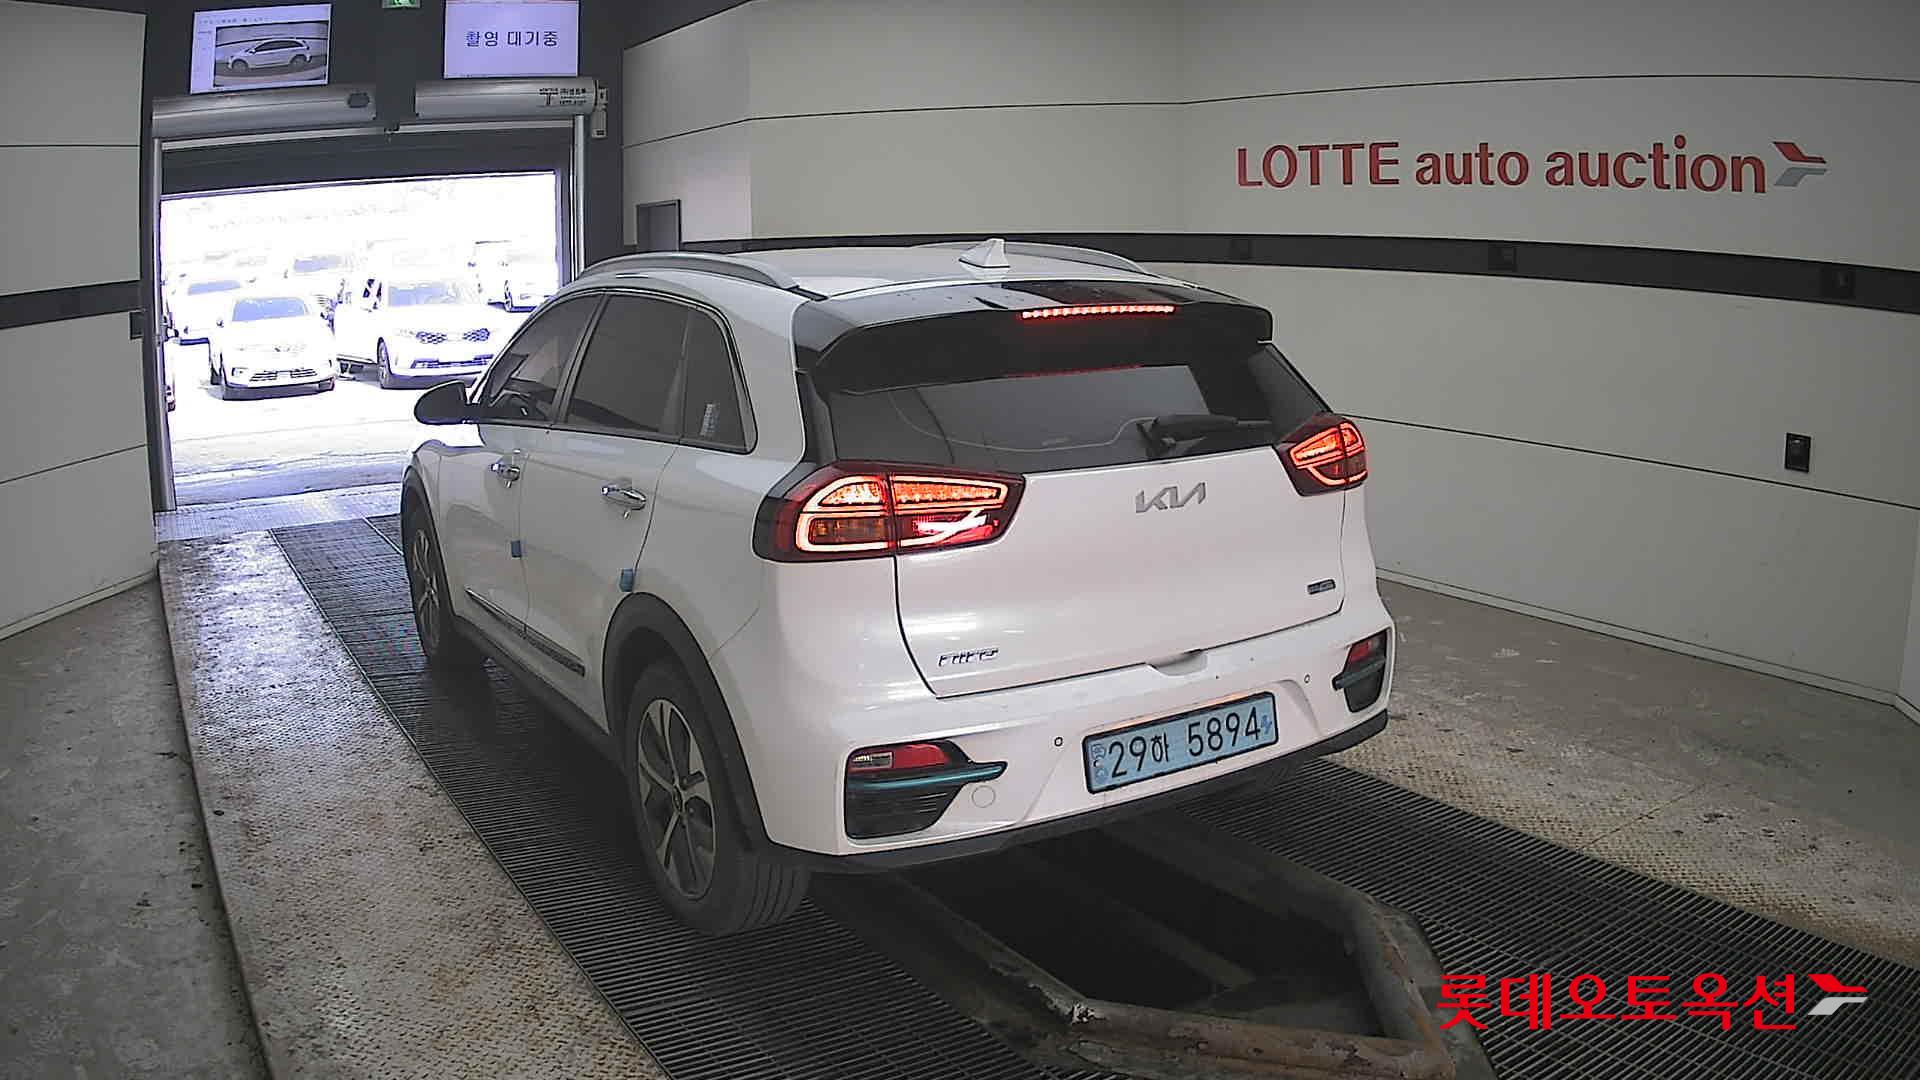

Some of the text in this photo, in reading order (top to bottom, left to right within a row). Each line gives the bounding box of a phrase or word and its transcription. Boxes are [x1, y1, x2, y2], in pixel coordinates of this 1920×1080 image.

[507, 31, 559, 47] 대기중
[1237, 135, 1767, 193] LOTTE auto auction
[1108, 706, 1261, 779] 29하 5894
